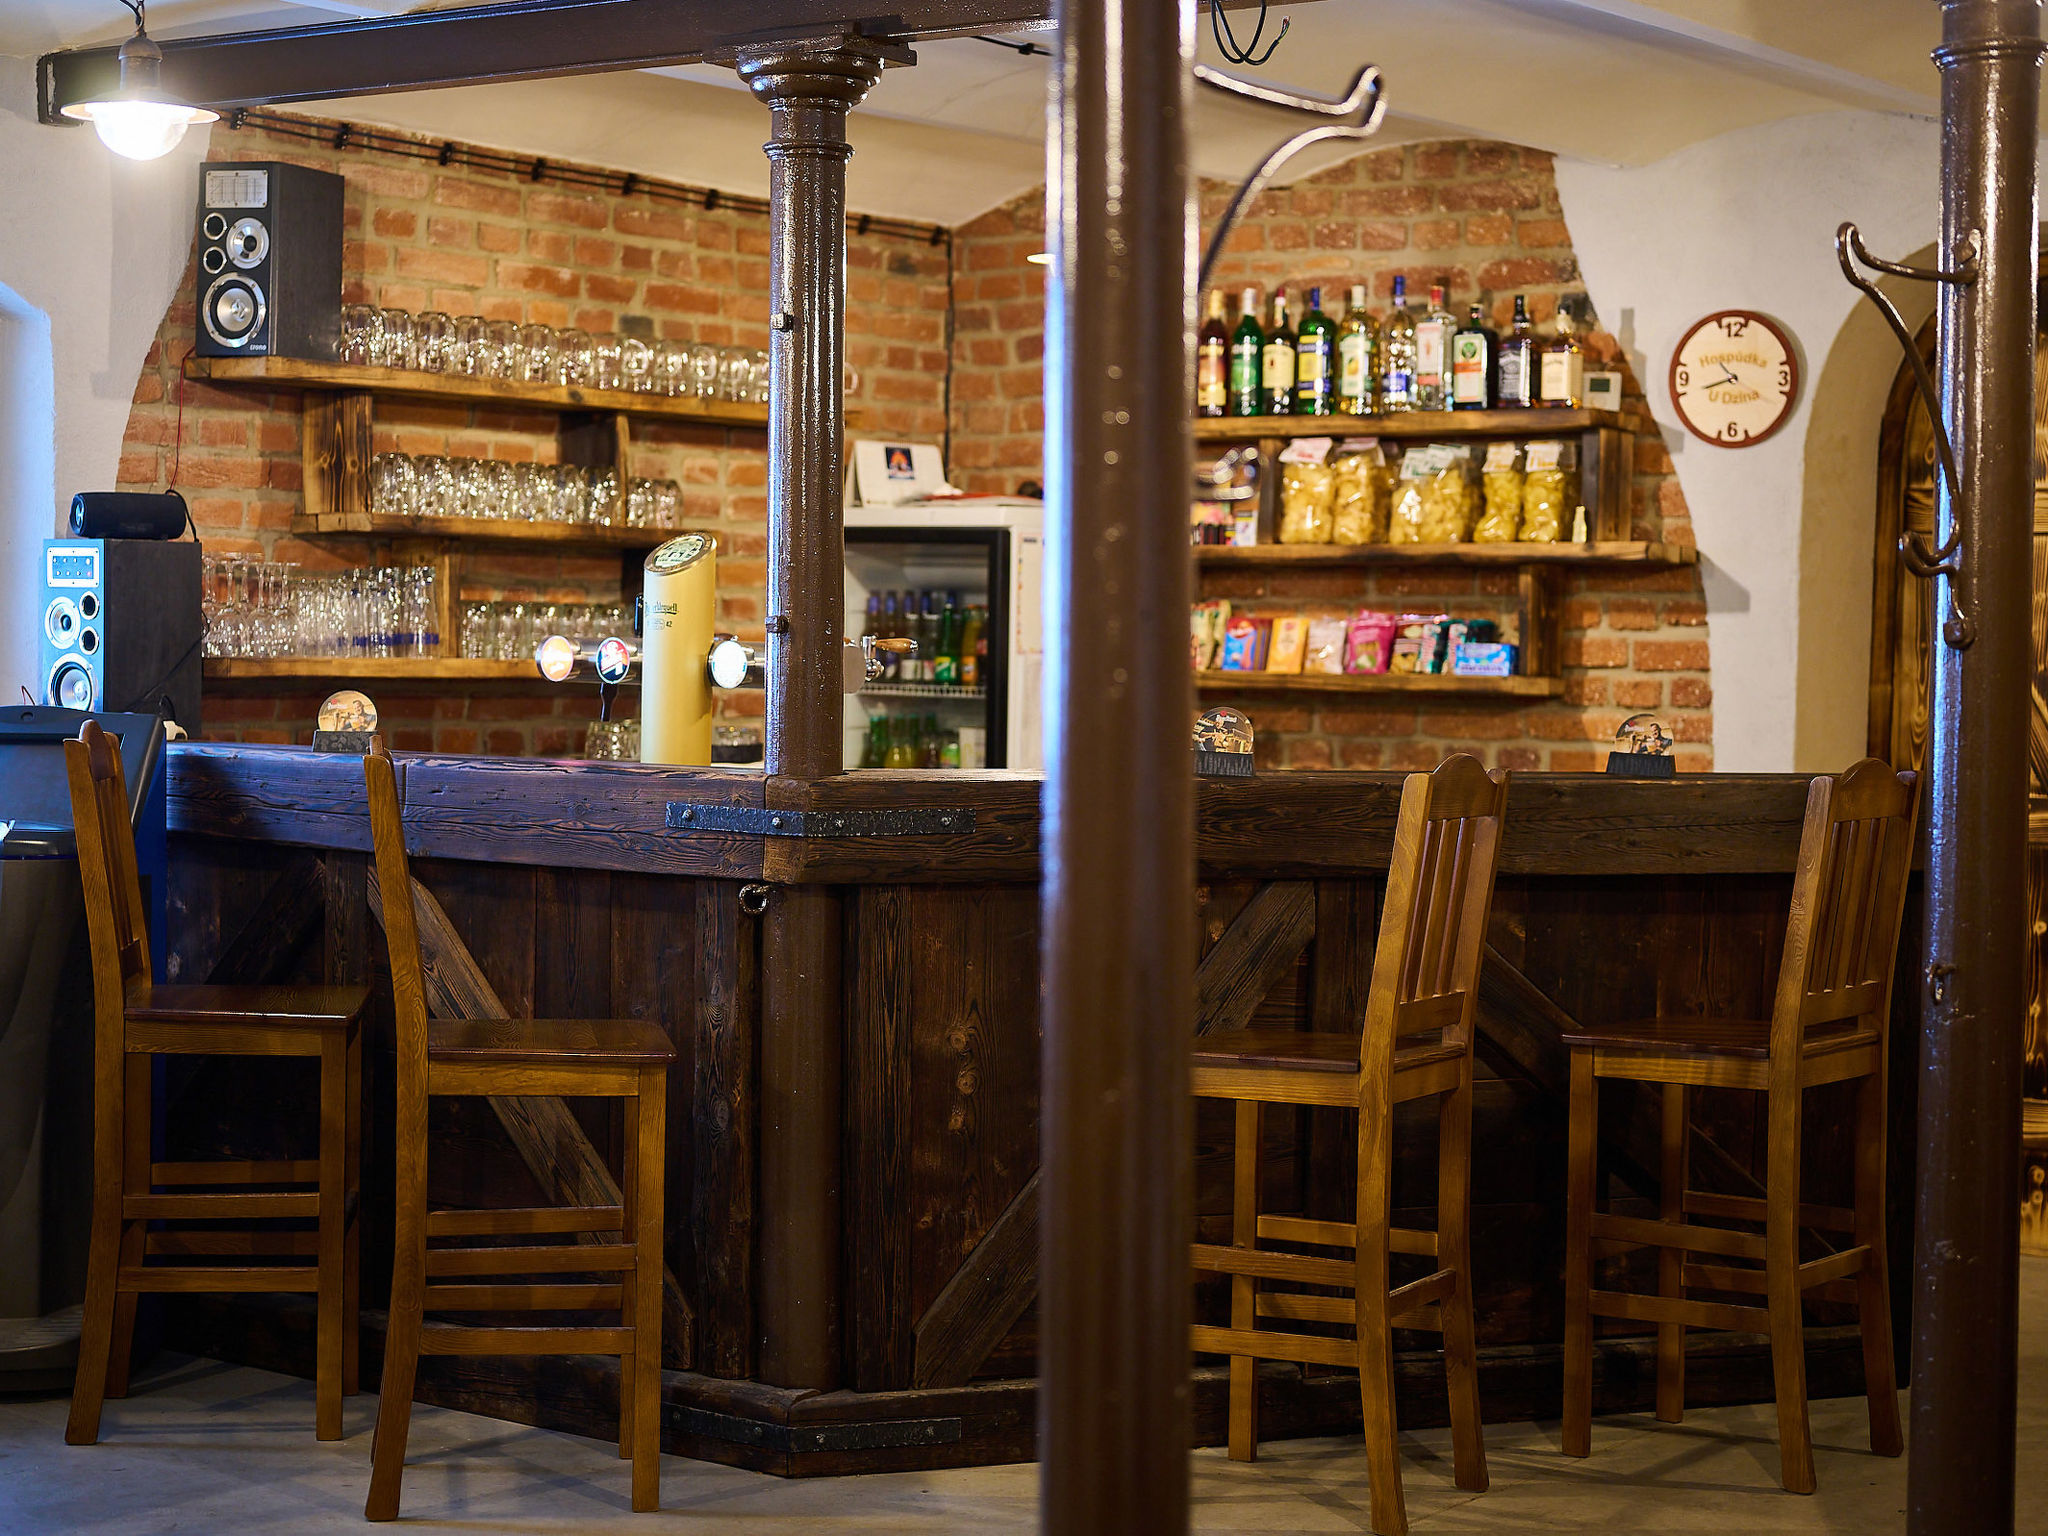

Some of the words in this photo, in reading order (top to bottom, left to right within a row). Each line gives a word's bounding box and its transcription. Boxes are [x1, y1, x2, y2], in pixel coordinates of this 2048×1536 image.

[1726, 322, 1744, 338] 12
[1679, 371, 1689, 386] 9
[1778, 370, 1788, 386] 3
[1727, 422, 1737, 437] 6
